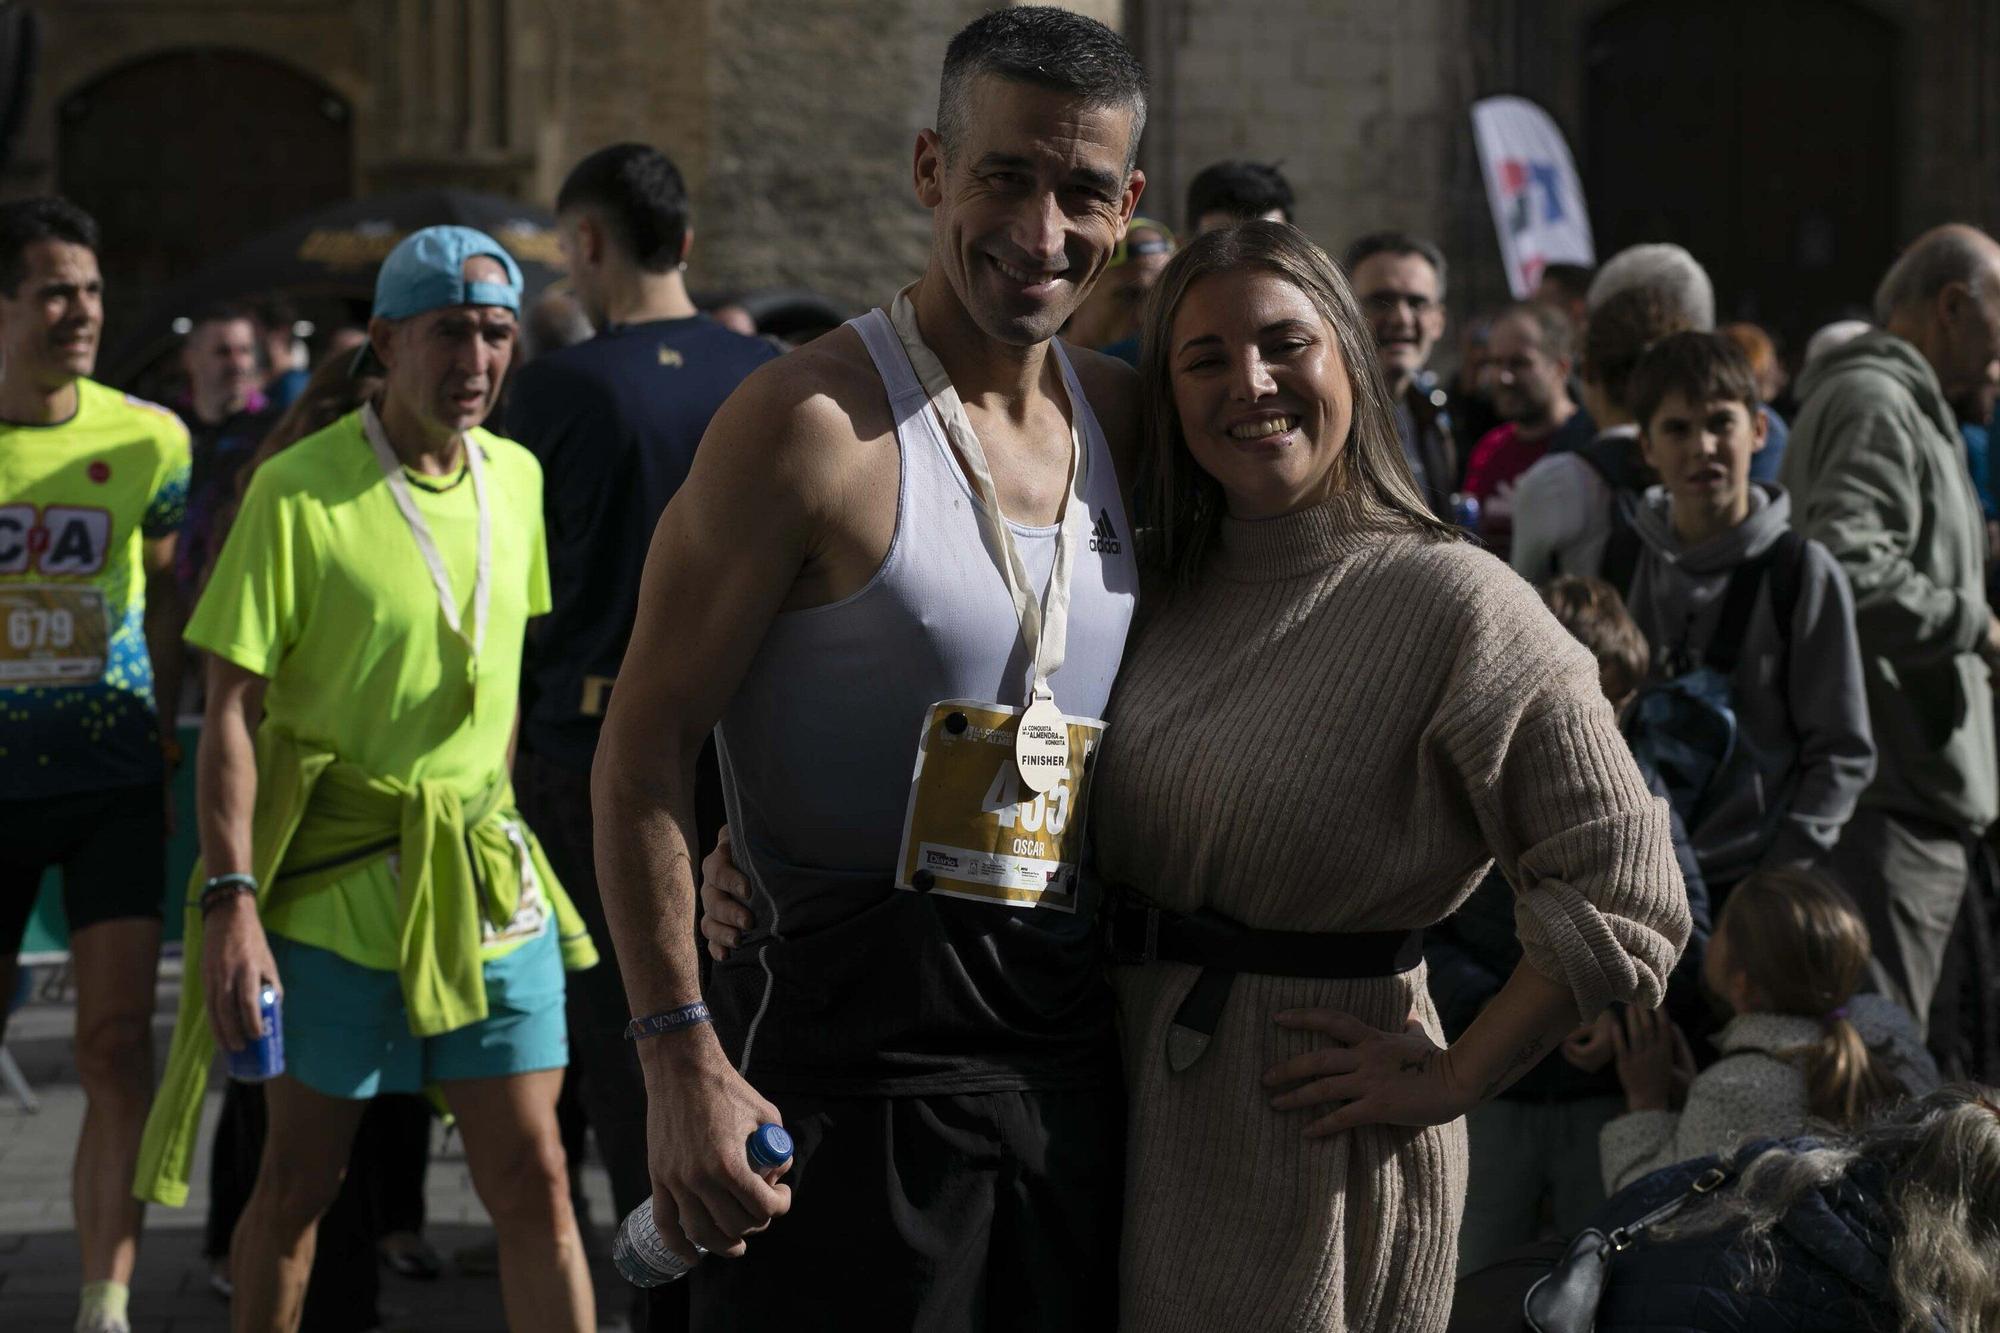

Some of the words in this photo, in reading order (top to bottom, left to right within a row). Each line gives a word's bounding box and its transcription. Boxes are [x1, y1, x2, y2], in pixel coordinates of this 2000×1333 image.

[8, 608, 74, 649] 679
[1029, 731, 1059, 739] ALMENDRA
[1022, 755, 1064, 766] FINISHER
[1013, 838, 1045, 857] OSCAR
